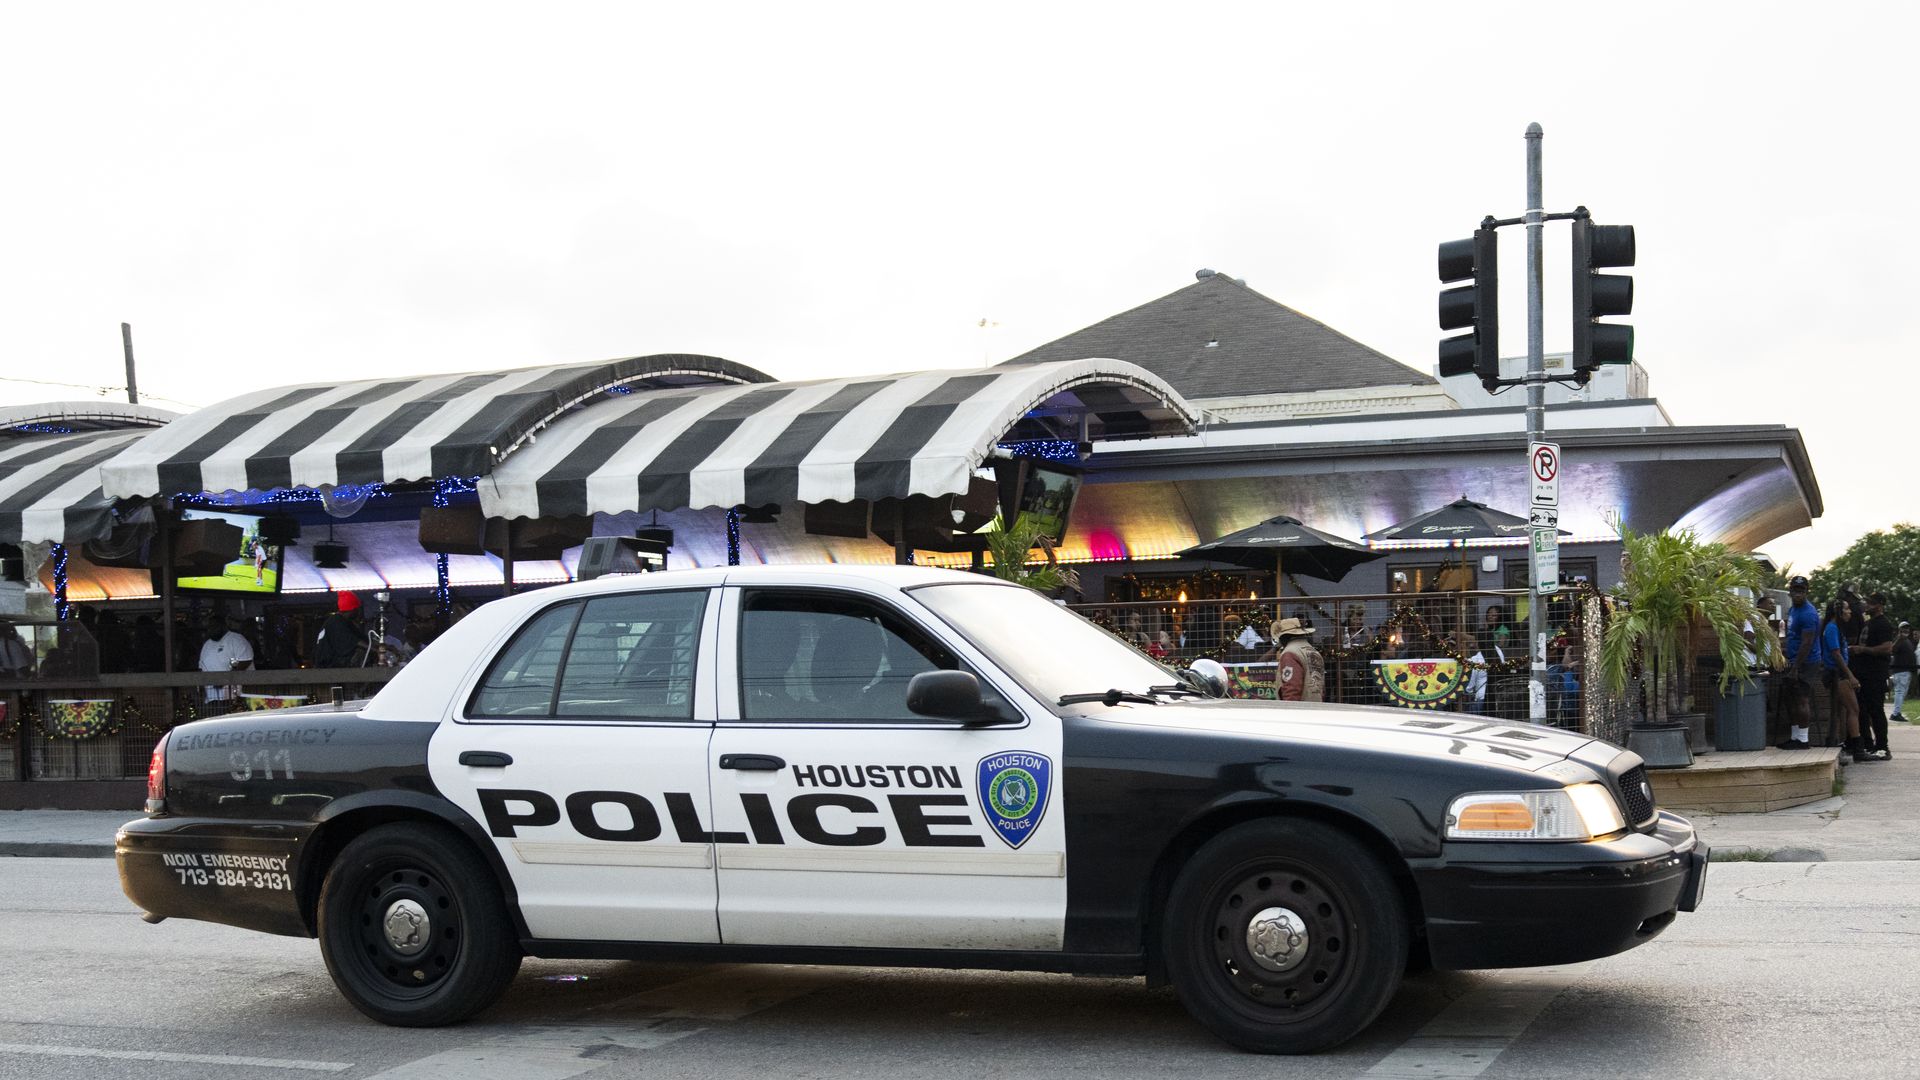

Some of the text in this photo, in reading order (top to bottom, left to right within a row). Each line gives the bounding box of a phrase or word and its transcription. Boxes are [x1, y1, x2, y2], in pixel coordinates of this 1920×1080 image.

[177, 728, 336, 751] EMERGENCY
[229, 749, 294, 781] 911
[987, 755, 1042, 772] HOUSTON
[792, 764, 963, 789] HOUSTON
[477, 788, 985, 848] POLICE
[998, 818, 1032, 830] POLICE
[163, 853, 287, 871] NON EMERGENCY
[175, 868, 292, 890] 713-884-3131
